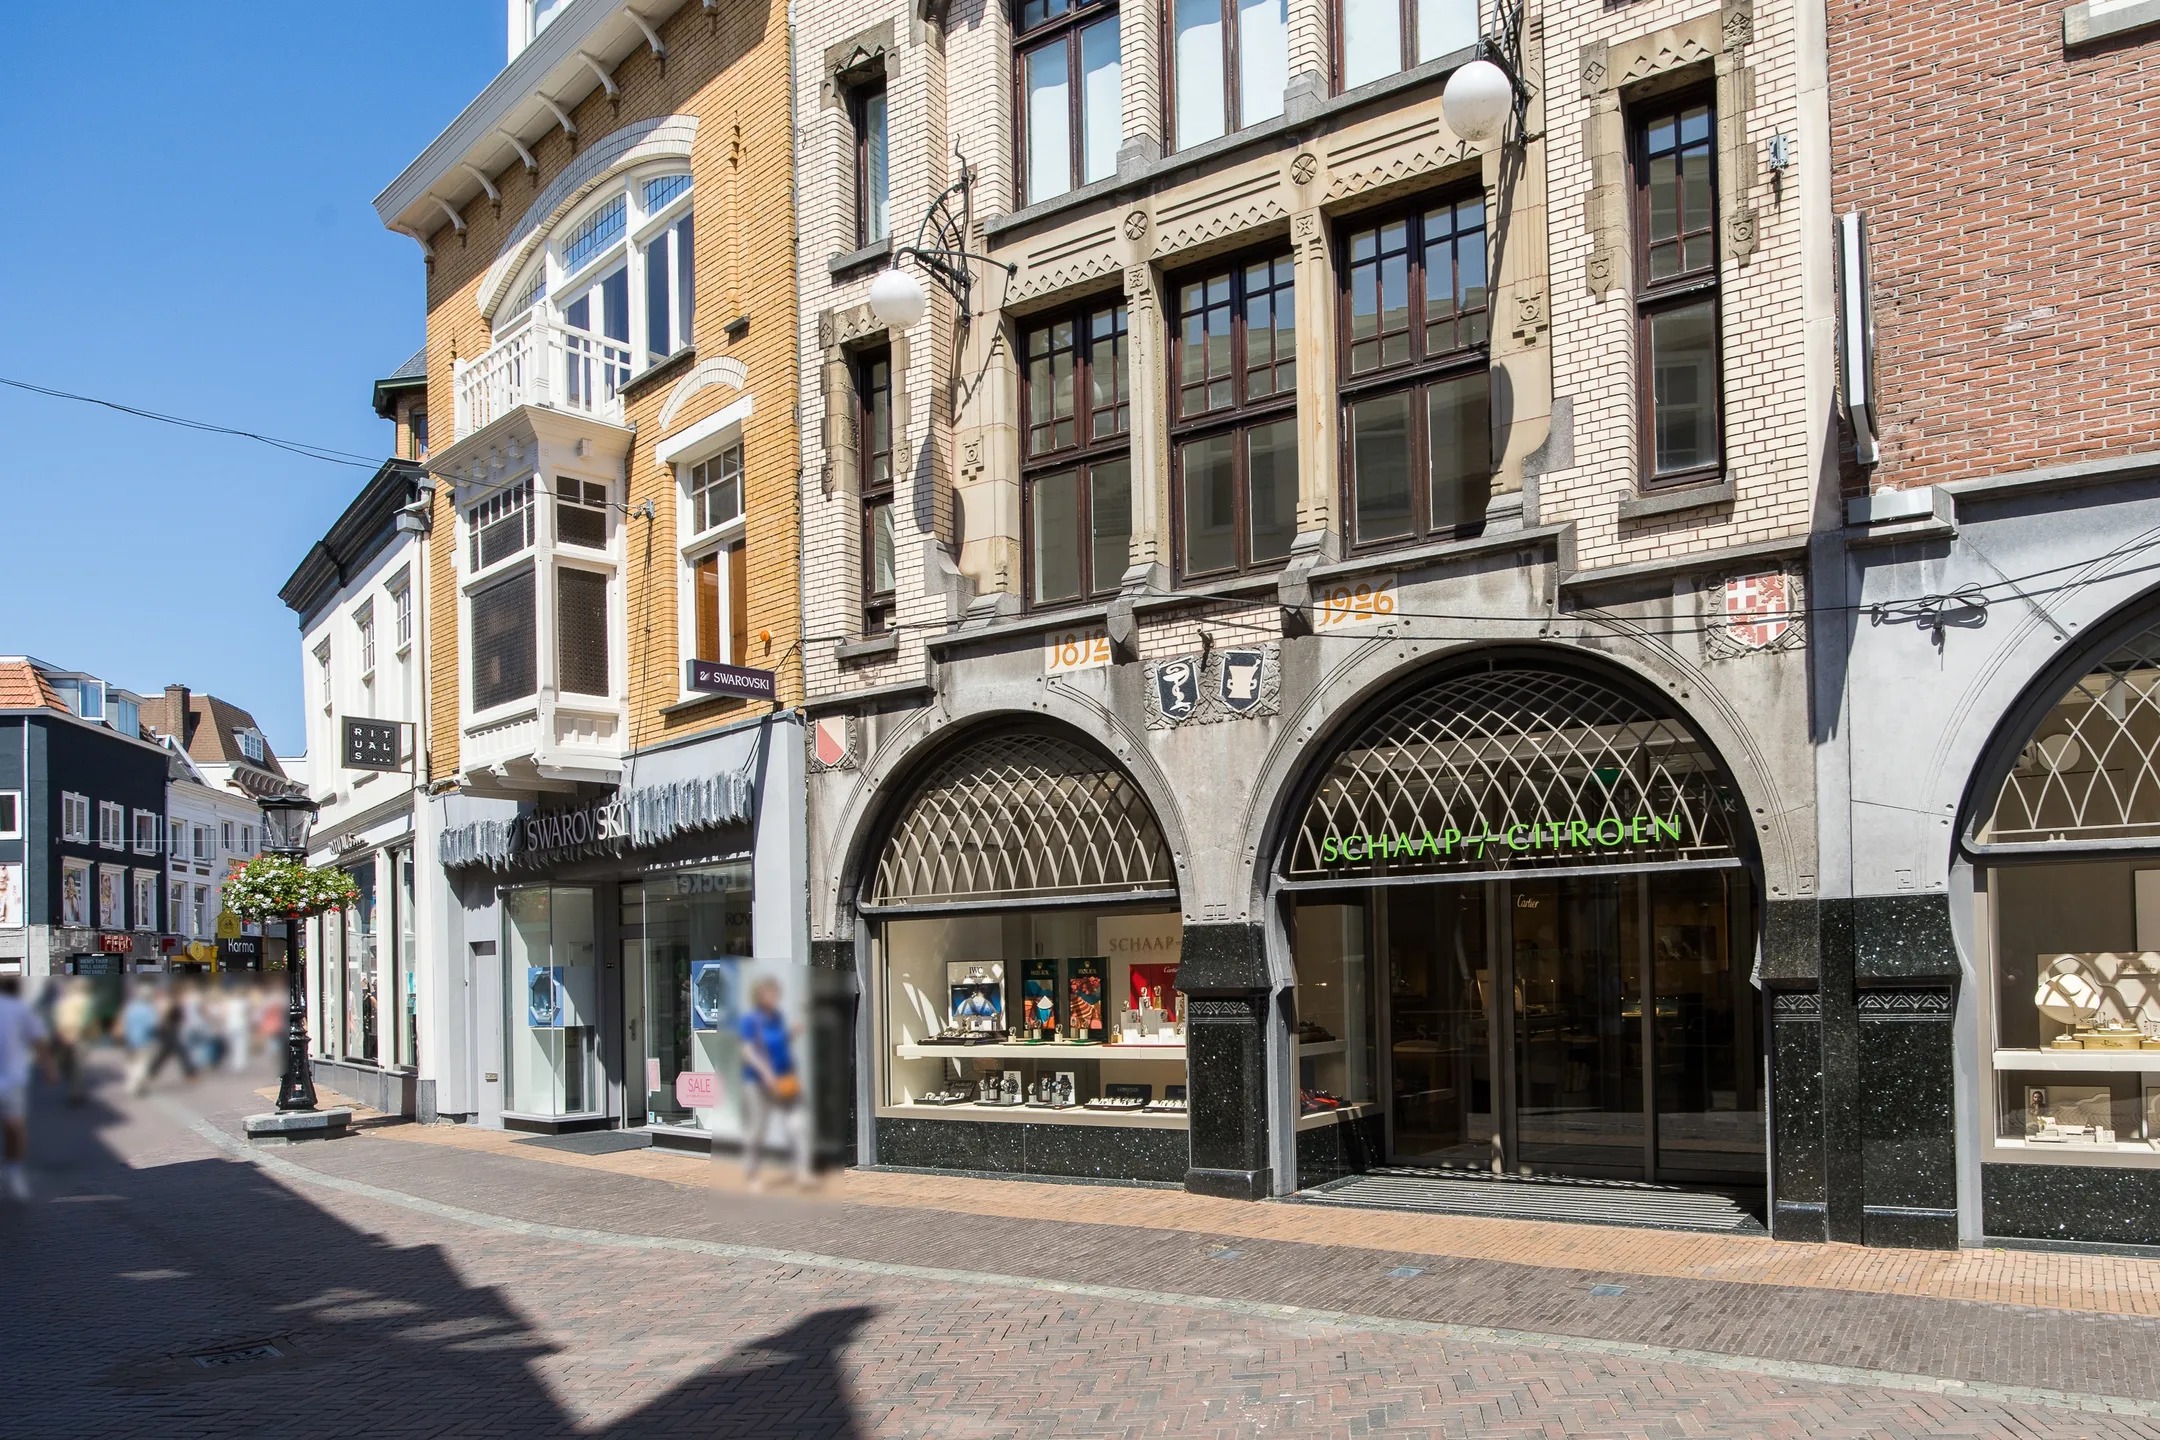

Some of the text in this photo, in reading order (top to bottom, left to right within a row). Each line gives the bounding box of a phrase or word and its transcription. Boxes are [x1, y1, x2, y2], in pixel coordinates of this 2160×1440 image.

[713, 672, 770, 690] SWAROVSKI
[527, 803, 630, 851] SWAROVSKI
[1324, 814, 1681, 862] SCHAAP CITROEN
[1517, 893, 1540, 909] Cartier
[228, 938, 255, 953] Karma
[1109, 935, 1174, 952] SCHAAP
[969, 967, 983, 975] IWC
[688, 1078, 711, 1093] SALE
